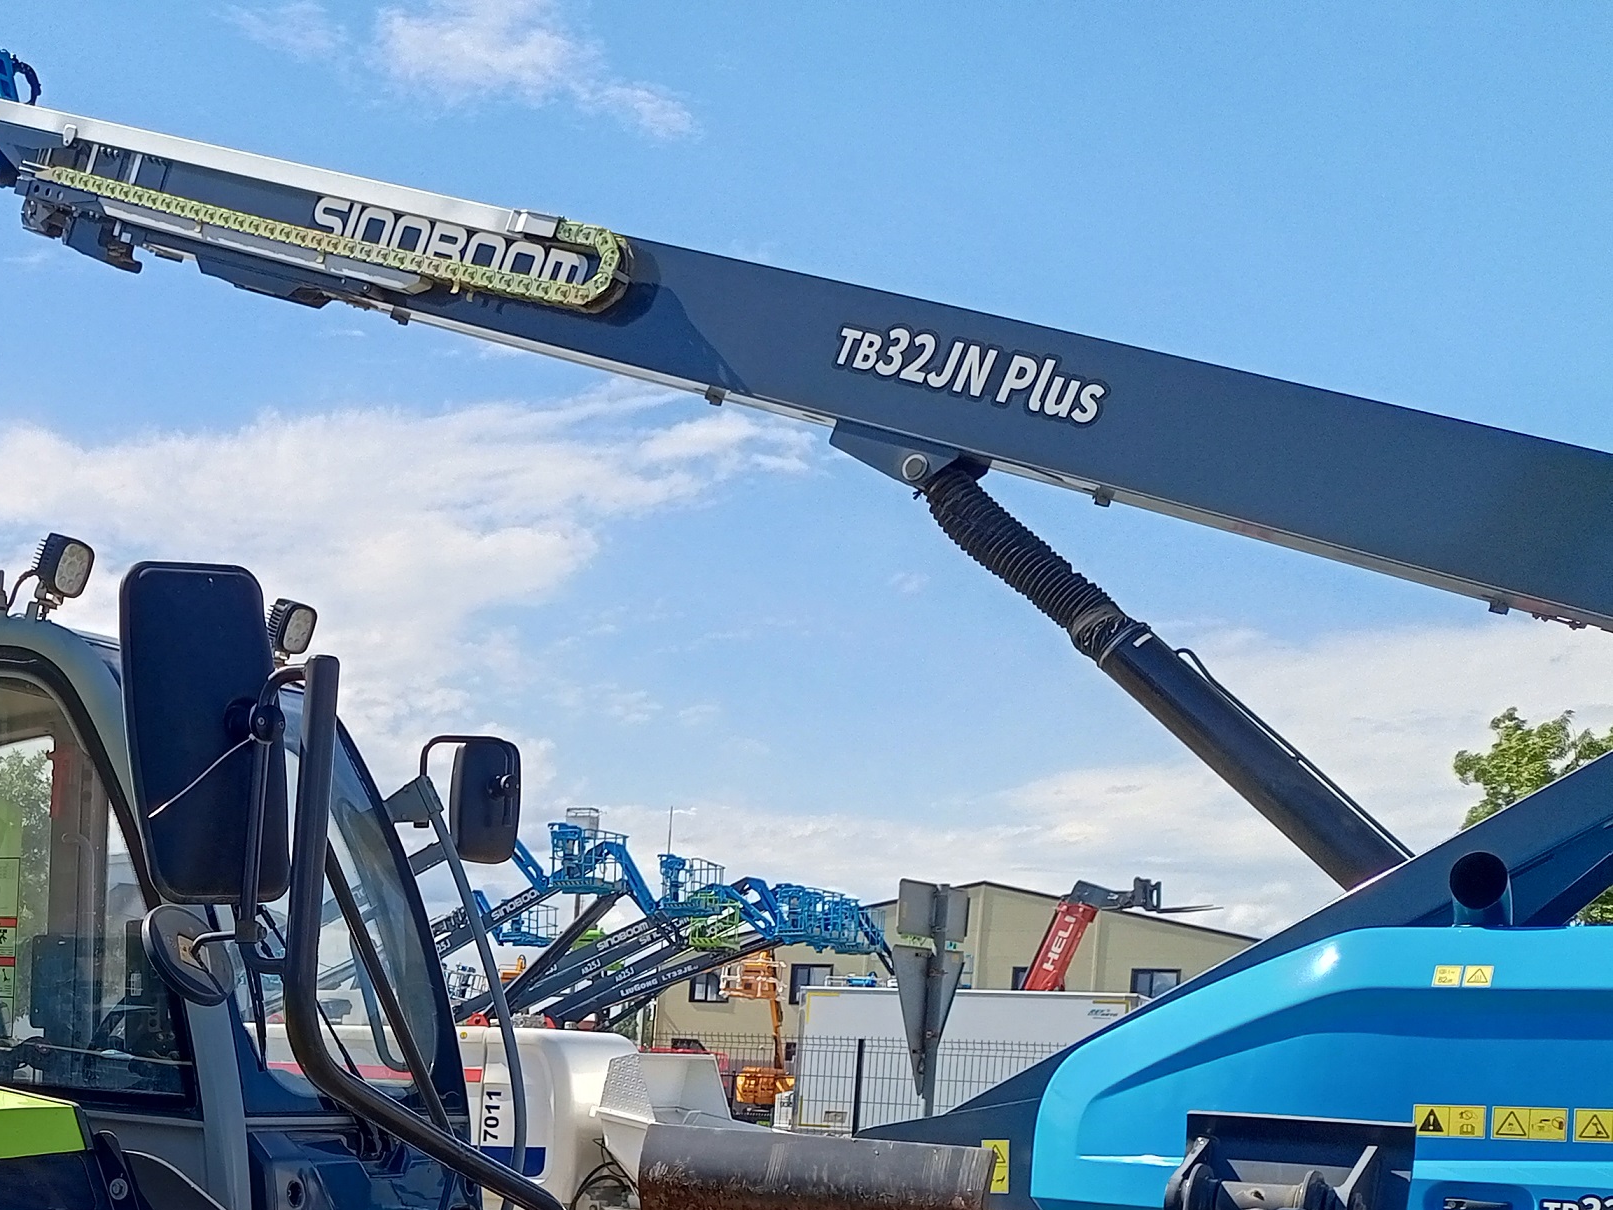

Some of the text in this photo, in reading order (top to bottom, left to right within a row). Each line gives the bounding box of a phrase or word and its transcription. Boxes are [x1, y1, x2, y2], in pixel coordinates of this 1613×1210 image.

[836, 327, 1106, 424] TB32JN Plus
[490, 887, 541, 922] SINOBOO
[596, 921, 649, 952] SINOBOOM
[1042, 914, 1077, 972] HELI
[483, 1091, 502, 1142] 7011
